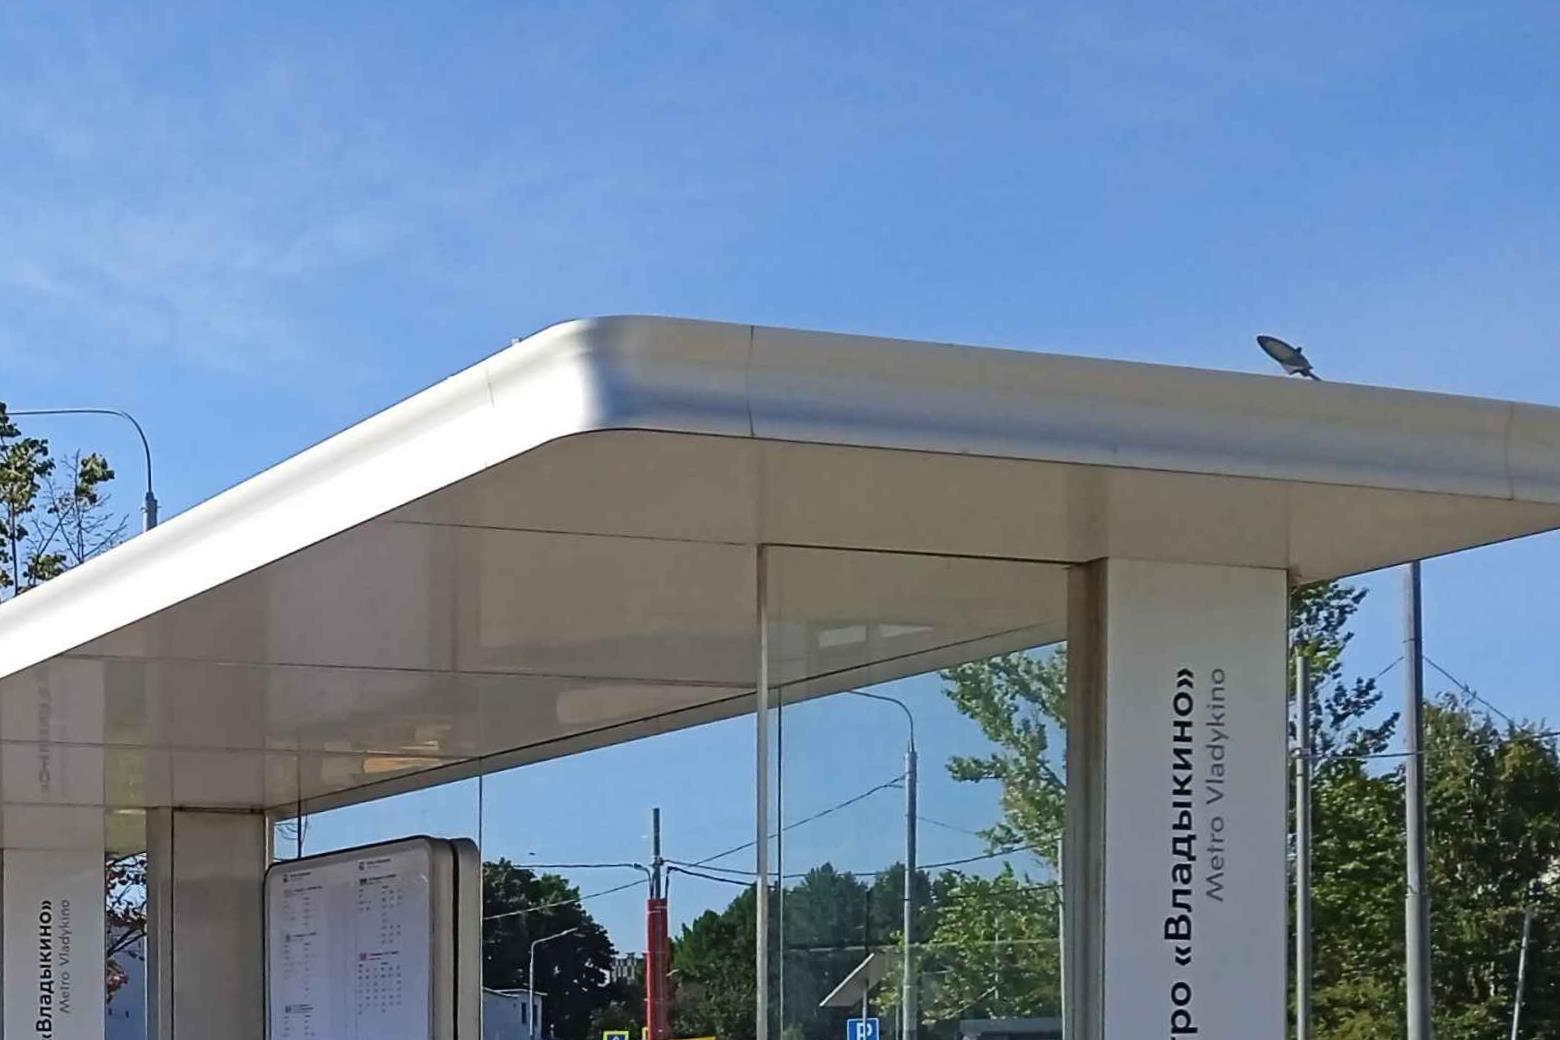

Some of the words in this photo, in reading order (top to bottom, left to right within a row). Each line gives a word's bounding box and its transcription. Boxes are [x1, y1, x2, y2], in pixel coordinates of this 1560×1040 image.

[1206, 667, 1230, 806] Vladykino
[1163, 667, 1197, 967] «Владыкино»
[1206, 815, 1226, 902] Metro
[59, 899, 72, 966] Vladykino
[59, 971, 71, 1014] Metro
